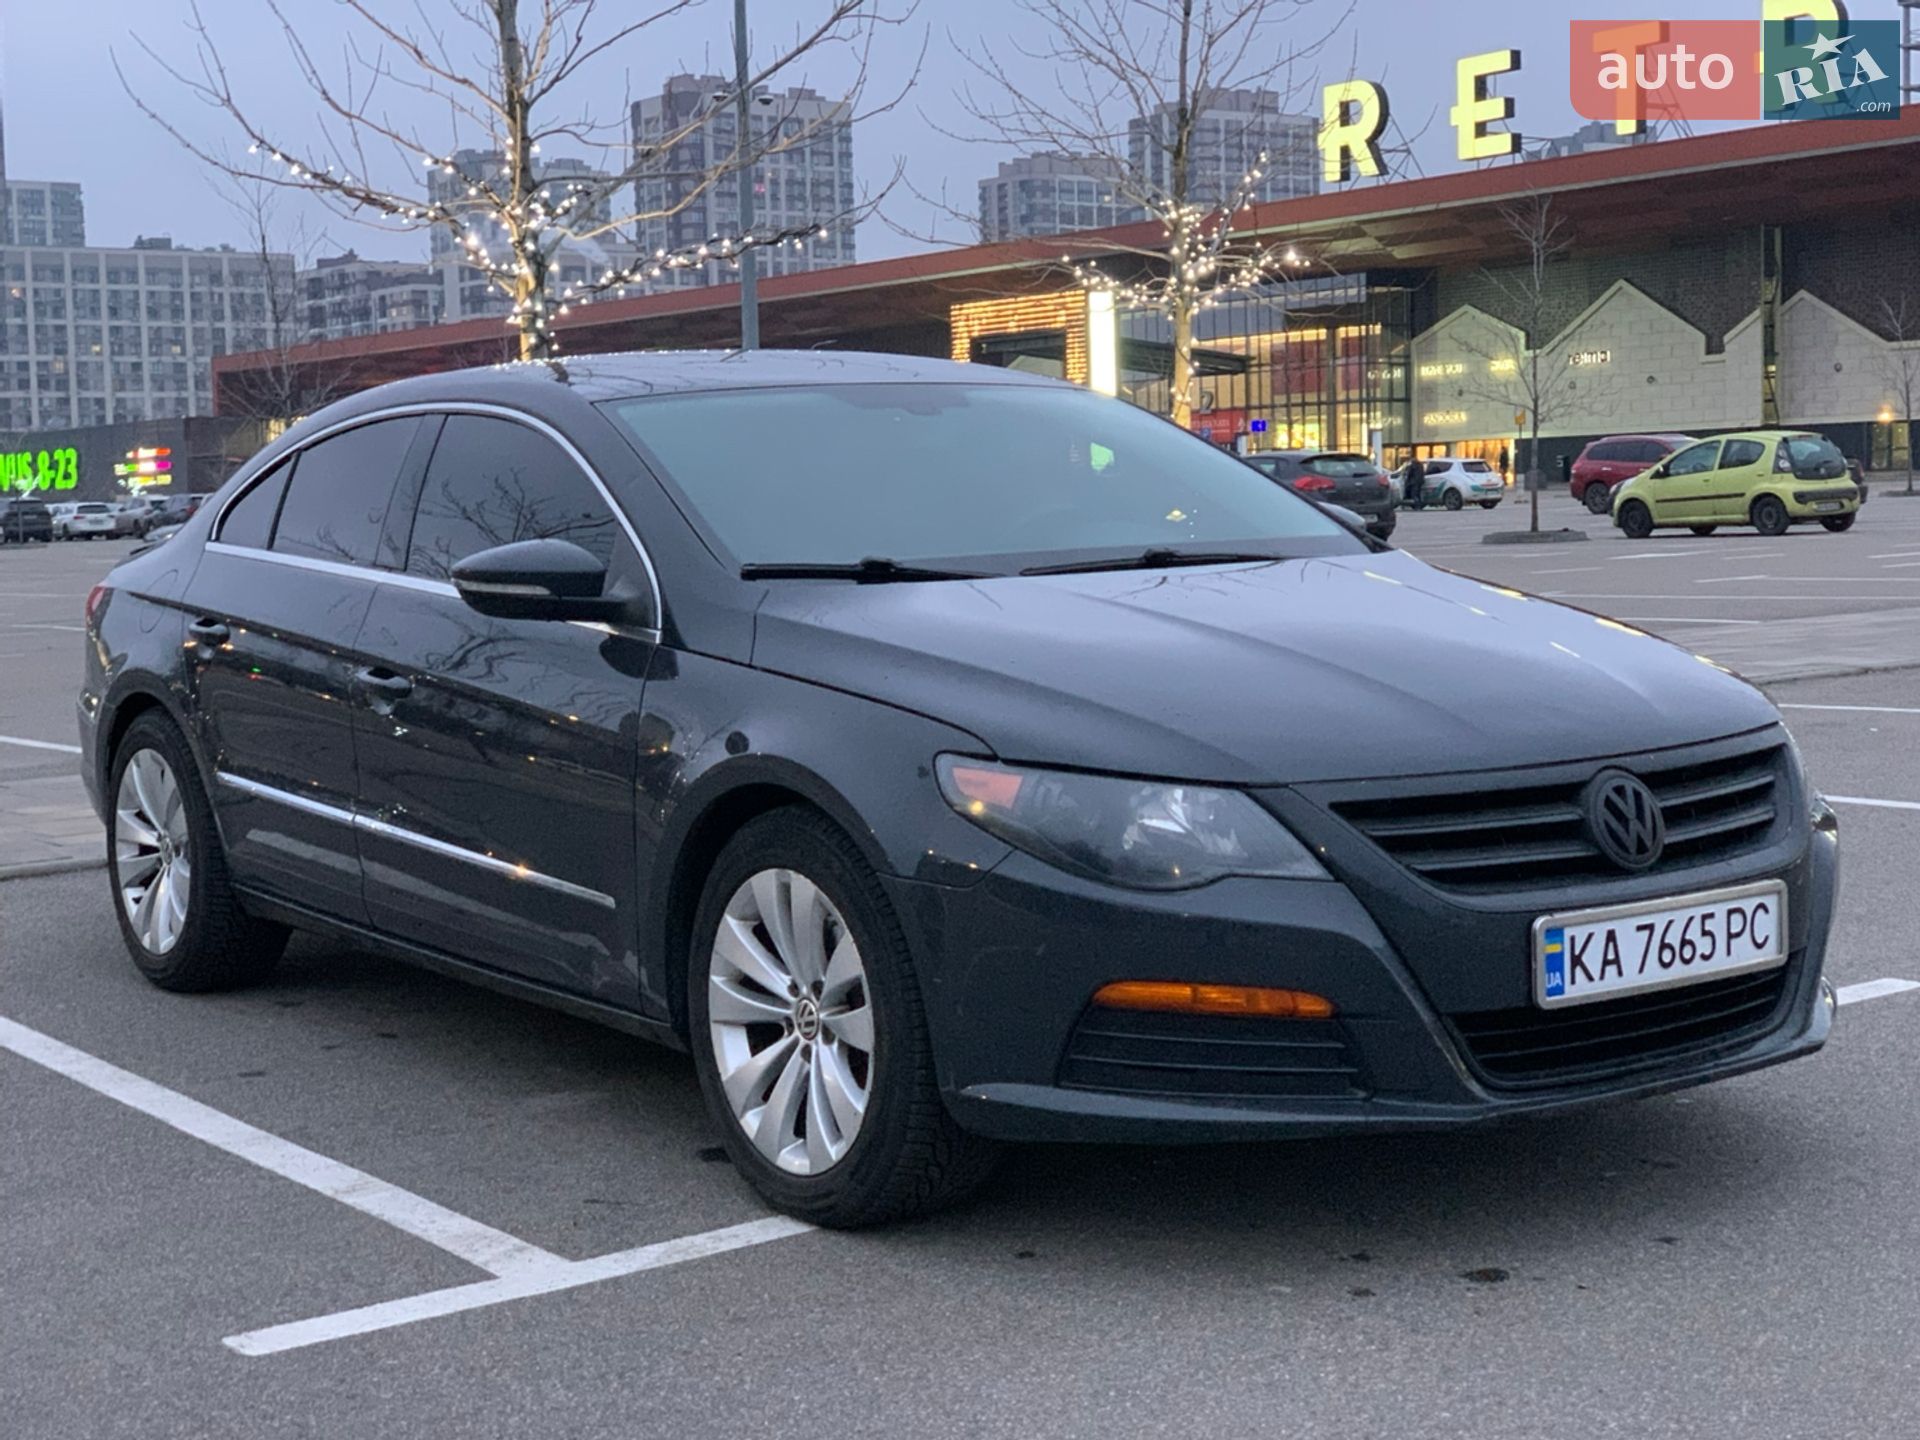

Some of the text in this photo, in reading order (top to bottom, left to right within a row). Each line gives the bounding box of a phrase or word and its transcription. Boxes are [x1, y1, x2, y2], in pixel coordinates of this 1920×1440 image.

[37, 448, 78, 491] 8-23
[1569, 901, 1770, 985] KA 7665 PC
[1545, 971, 1562, 988] UA
